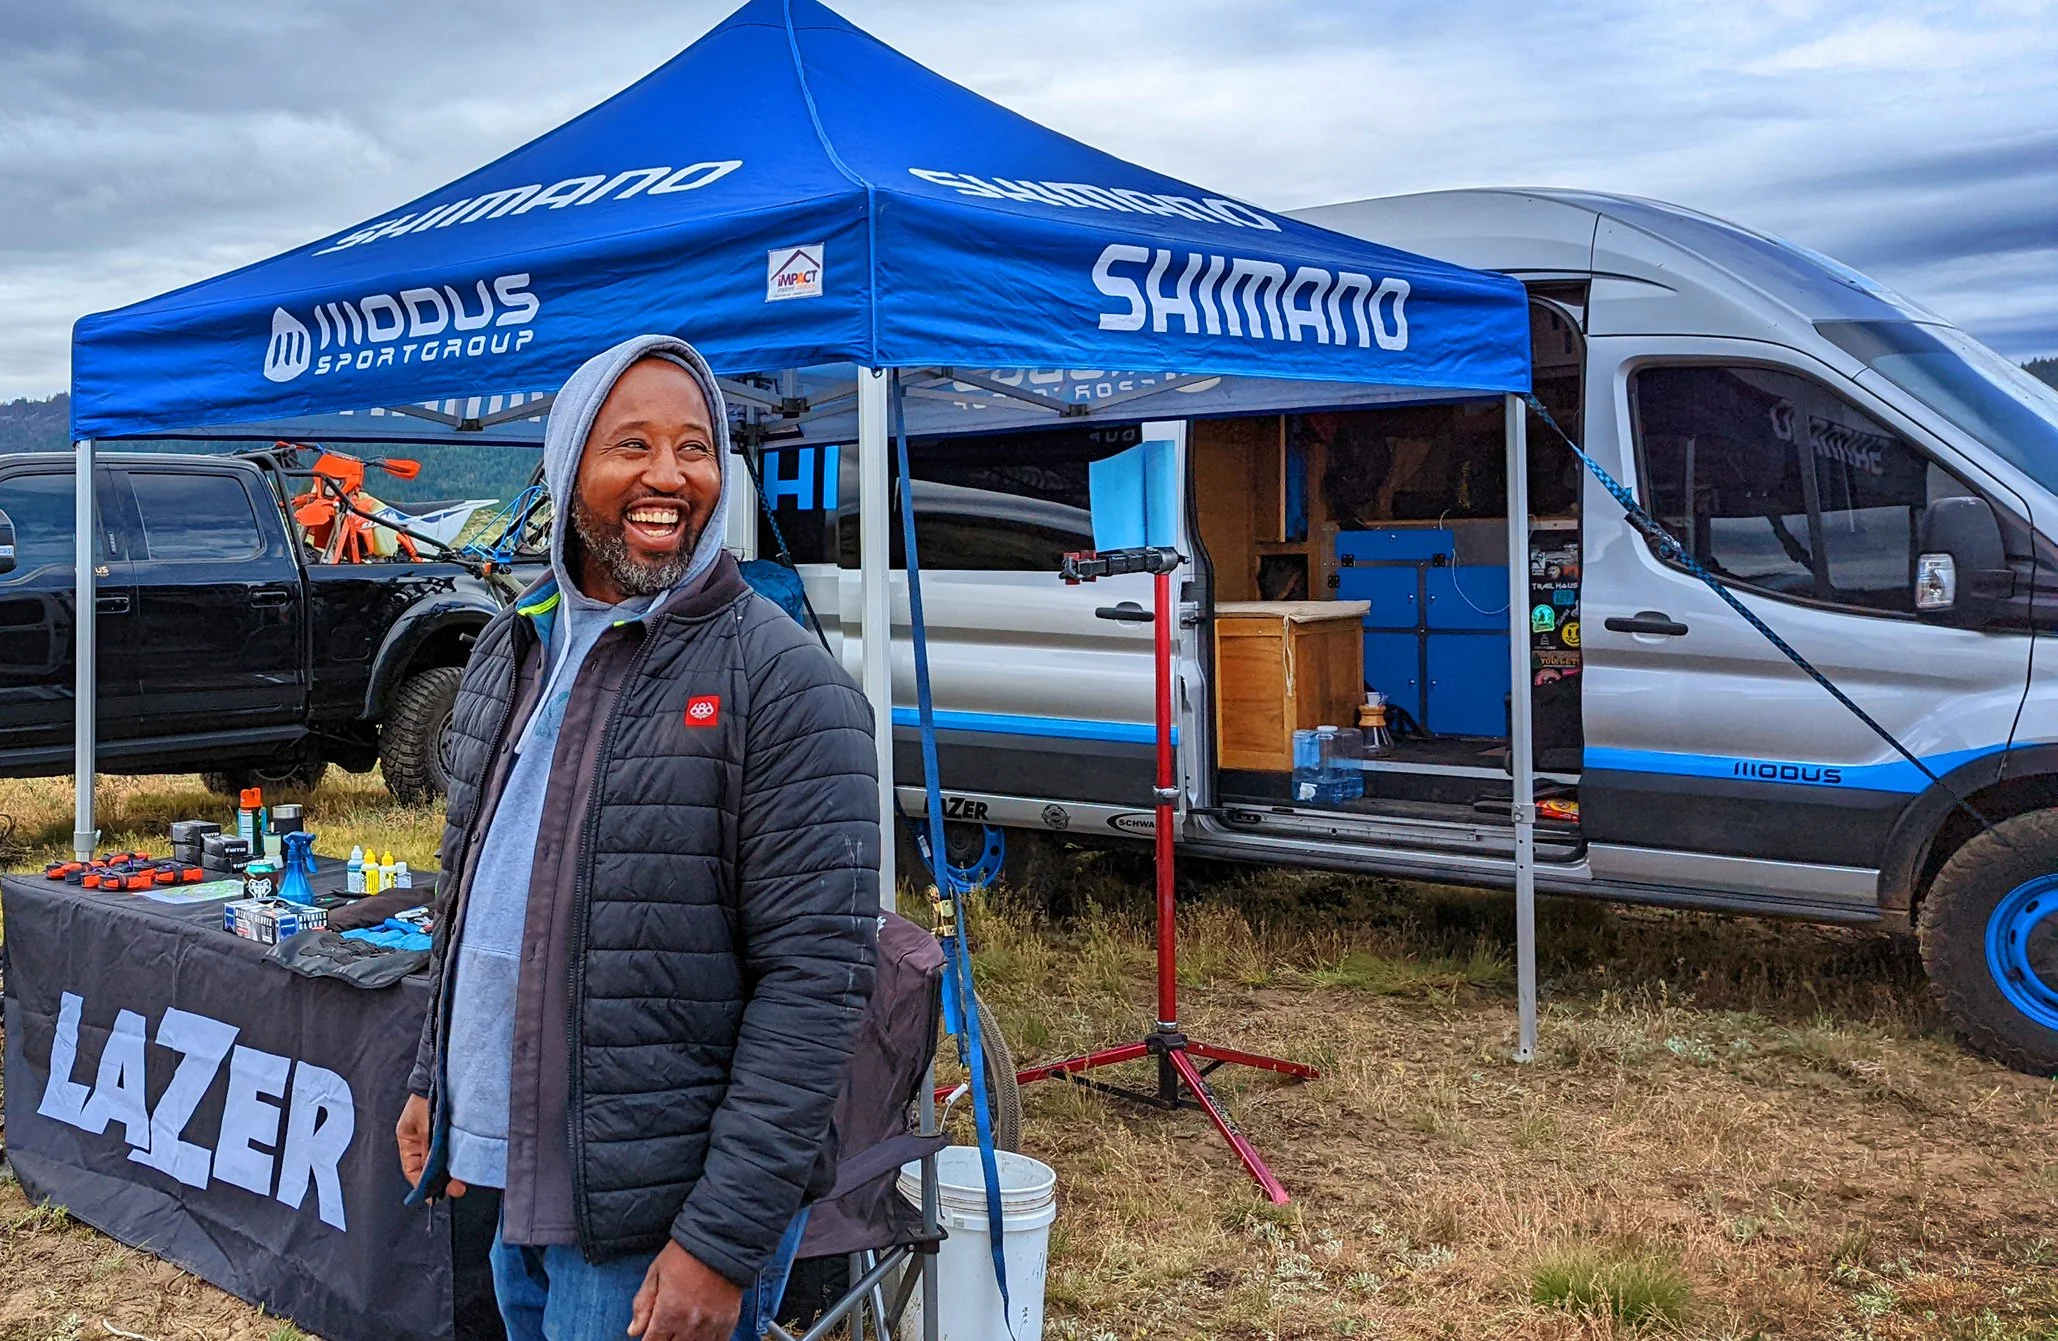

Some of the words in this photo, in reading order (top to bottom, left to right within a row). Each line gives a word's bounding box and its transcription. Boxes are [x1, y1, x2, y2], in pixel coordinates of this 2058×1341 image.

[311, 160, 743, 257] SHIMANO
[908, 167, 1282, 232] SHIMANO
[314, 273, 540, 350] MODUS
[1091, 243, 1411, 351] SHIMANO
[314, 329, 534, 375] SPORTGROUP
[763, 445, 840, 511] HI
[1734, 762, 1842, 784] MODUS
[298, 911, 327, 922] NITRILE
[36, 991, 356, 1233] LAZER
